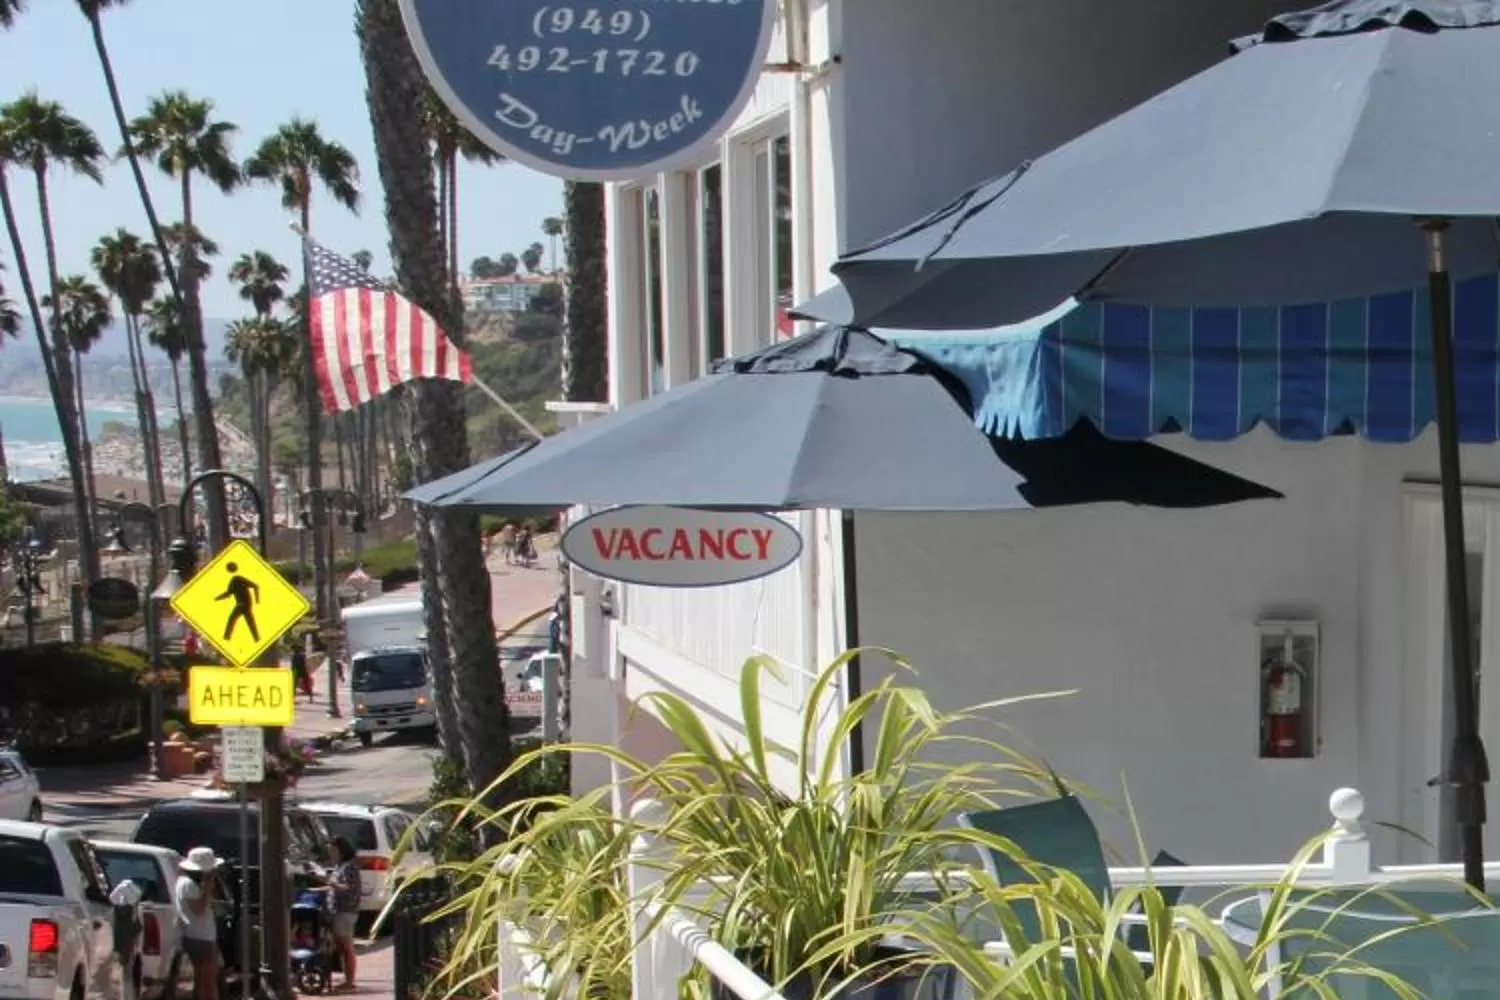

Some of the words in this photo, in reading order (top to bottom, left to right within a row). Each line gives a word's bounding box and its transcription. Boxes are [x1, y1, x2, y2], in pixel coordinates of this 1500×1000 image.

[532, 7, 651, 41] (949)
[487, 45, 700, 76] 492-1720
[591, 527, 774, 561] VACANCY
[201, 684, 284, 708] AHEAD
